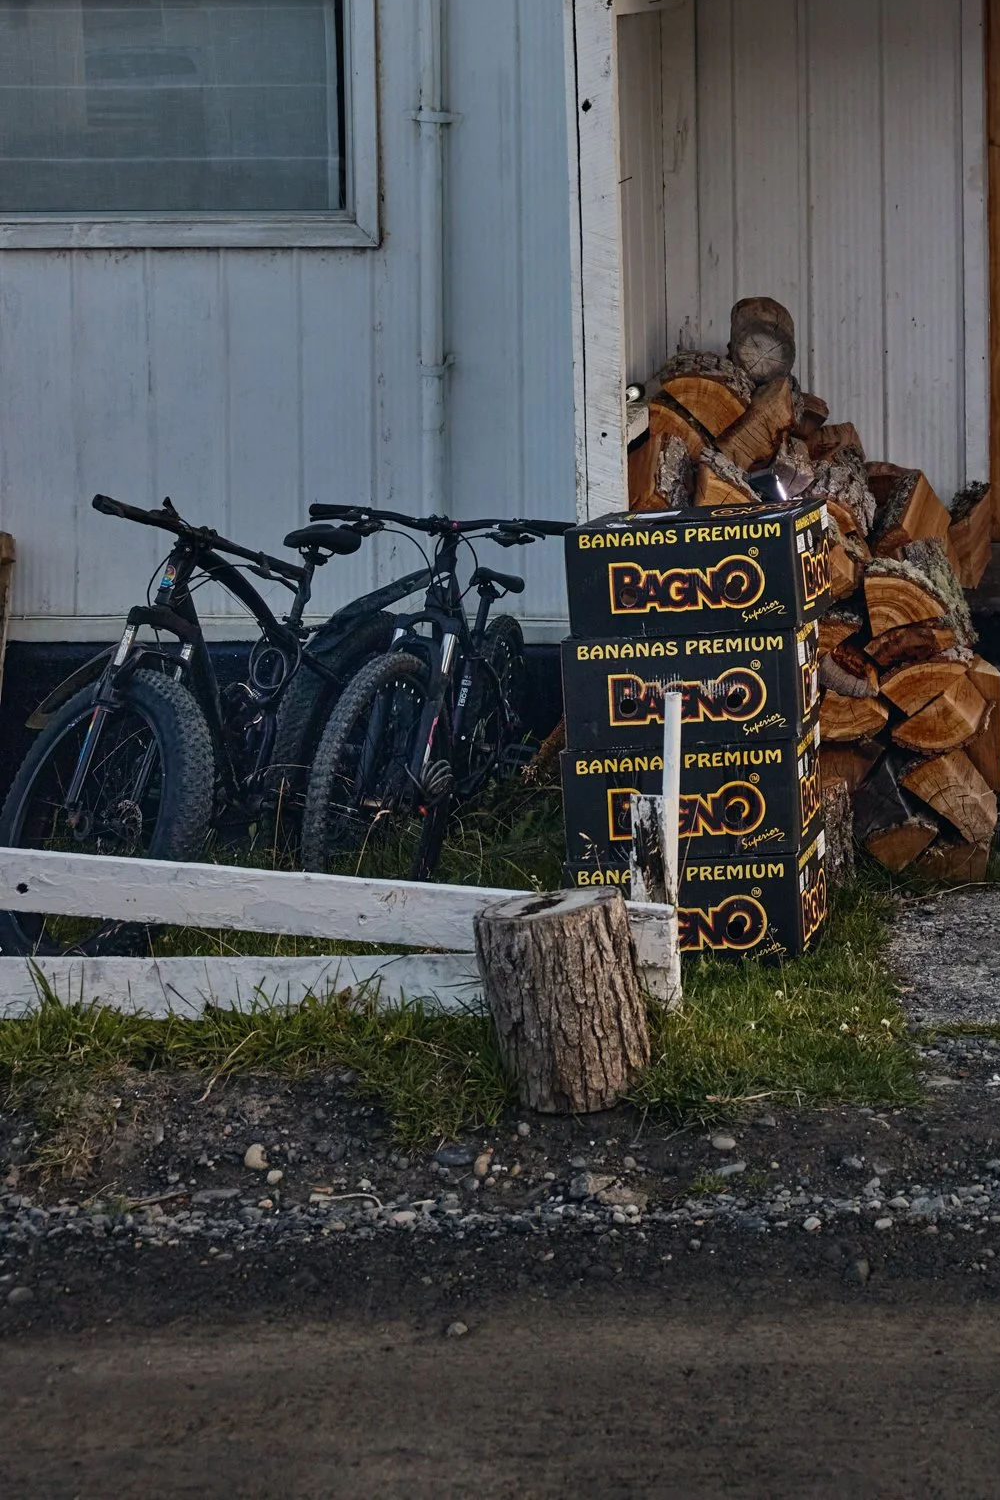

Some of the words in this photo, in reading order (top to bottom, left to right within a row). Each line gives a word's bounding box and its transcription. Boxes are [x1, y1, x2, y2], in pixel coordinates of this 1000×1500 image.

[578, 529, 678, 549] BANANAS
[684, 522, 781, 543] PREMIUM
[608, 554, 766, 614] BAGNO
[742, 600, 782, 623] Superior
[577, 640, 679, 661] BANANAS
[685, 635, 783, 656] PREMIUM
[743, 713, 782, 736] Superior
[575, 755, 663, 775] BANANA
[684, 748, 782, 769] PREMIUM
[742, 827, 782, 850] Superior
[577, 869, 632, 886] BANA
[686, 862, 784, 882] PREMIUM
